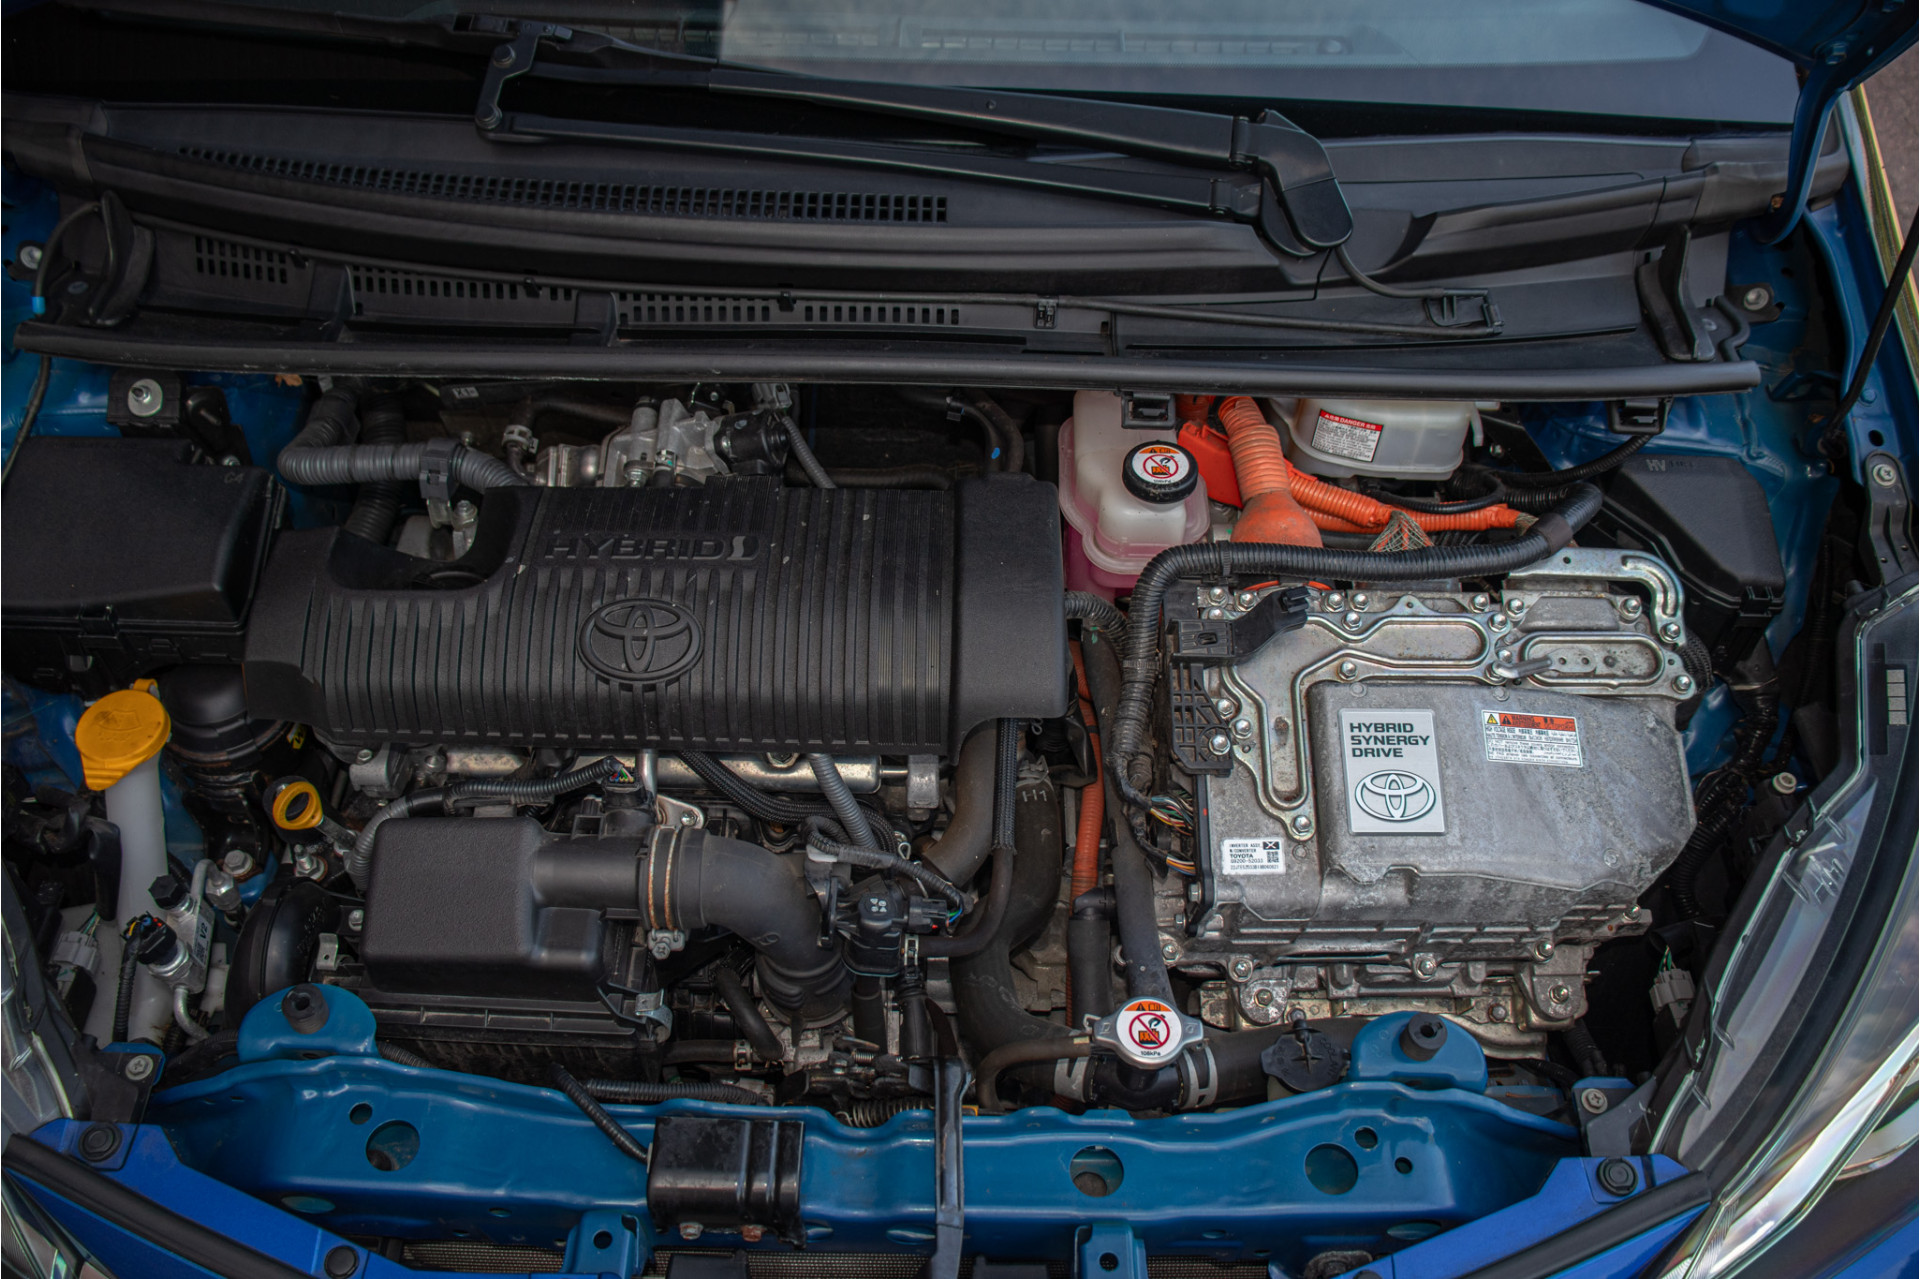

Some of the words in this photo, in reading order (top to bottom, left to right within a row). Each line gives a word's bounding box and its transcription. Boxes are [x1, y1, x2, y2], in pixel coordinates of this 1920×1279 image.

[1340, 417, 1366, 428] DANGER
[544, 536, 726, 560] HYBRID
[1349, 722, 1415, 733] HYBRID
[1350, 735, 1430, 746] SYNERGY
[1351, 747, 1404, 758] DRIVE
